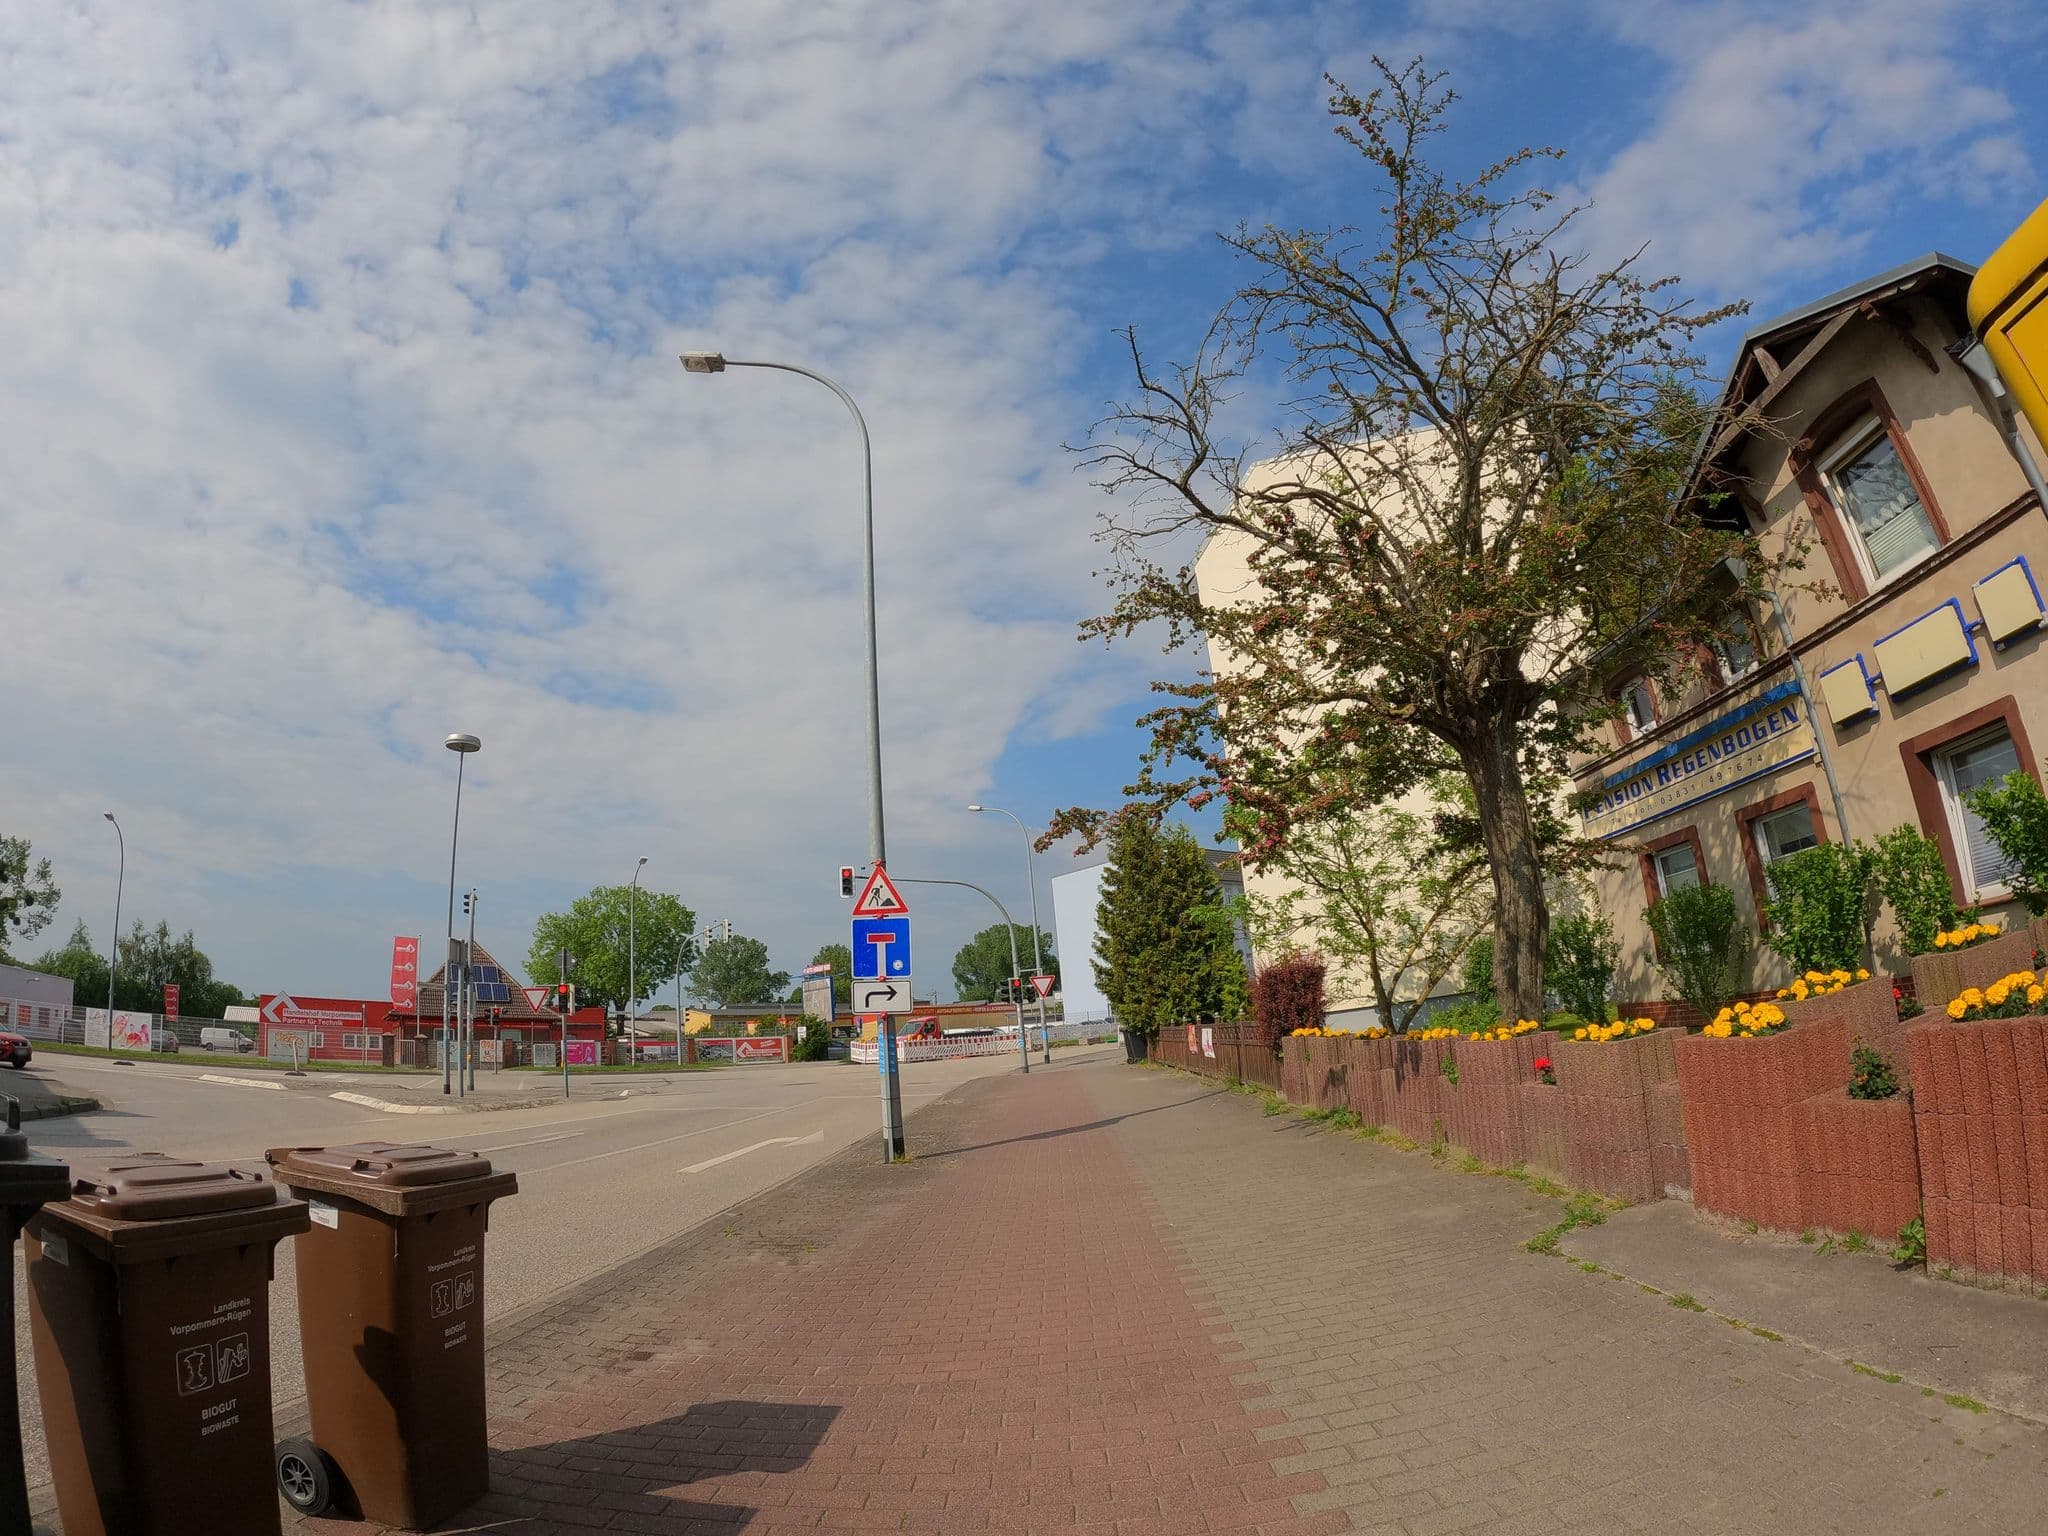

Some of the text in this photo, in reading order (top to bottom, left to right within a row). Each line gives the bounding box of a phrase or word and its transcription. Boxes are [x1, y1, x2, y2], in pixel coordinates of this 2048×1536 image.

[1660, 784, 1696, 806] 03831
[283, 1017, 306, 1025] Partner
[317, 1018, 343, 1026] Technik
[213, 1298, 251, 1314] Landkreis
[170, 1308, 252, 1336] Vorpommern-Rügen
[201, 1398, 237, 1420] BIOGUT
[201, 1415, 240, 1436] BIOWASTE
